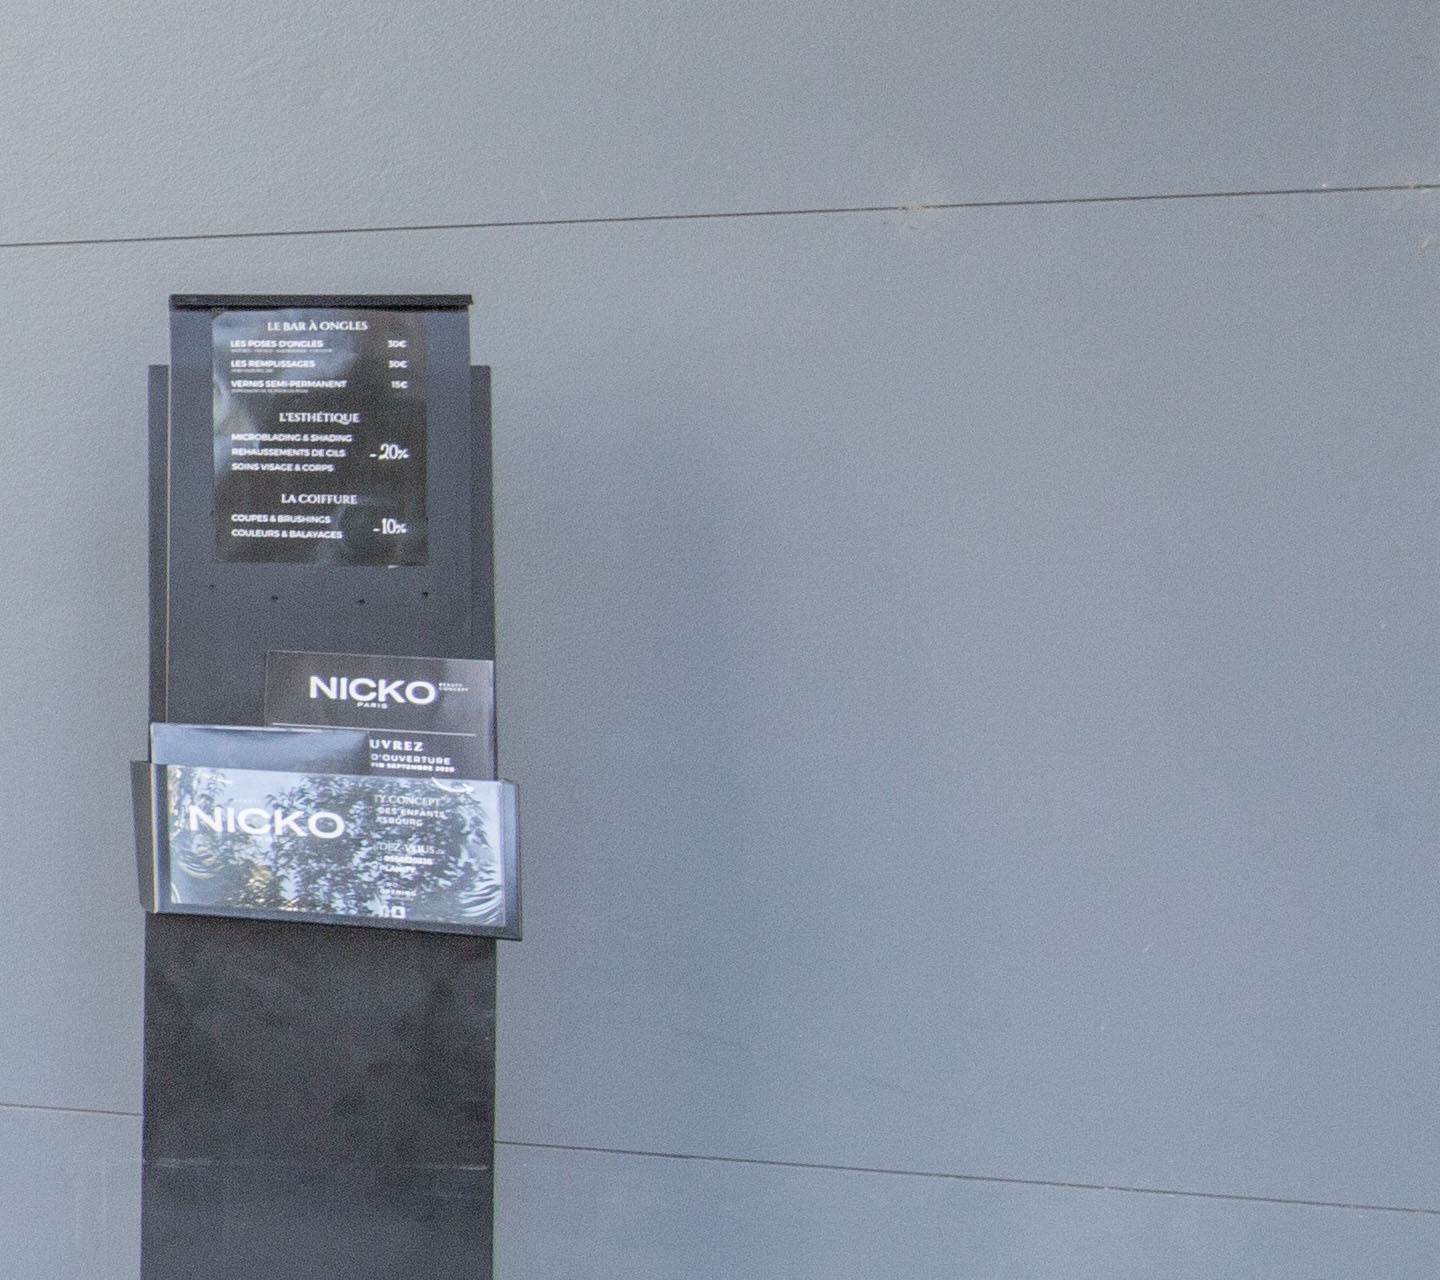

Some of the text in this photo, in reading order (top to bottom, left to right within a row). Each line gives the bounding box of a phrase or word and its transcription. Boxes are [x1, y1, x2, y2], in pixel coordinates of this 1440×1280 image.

[267, 320, 368, 331] LE BAR À ONGLES
[231, 340, 407, 348] LES POSES D'ONGLES 30€
[231, 360, 408, 368] LES REMPLISSAGES 30€
[231, 380, 408, 389] VERNIS SEMI-PERMANENT 15€
[280, 411, 360, 425] L'ESTHÉTIQUE
[231, 433, 353, 442] MICROBLADING & SHADING
[231, 448, 346, 457] REHAUSSEMENTS DE CILS
[231, 463, 334, 472] SOINS VISAGE & CORPS
[281, 493, 358, 504] LA COIFFURE
[231, 514, 332, 524] COUPES & BRUSHINGS
[231, 529, 343, 539] COULEURS & BALAYAGES
[309, 675, 438, 705] NICKO
[369, 739, 424, 751] UVREZ
[371, 753, 451, 765] D'OUVERTURE
[386, 763, 433, 771] SEPTEMBRE
[188, 804, 345, 839] NICKO
